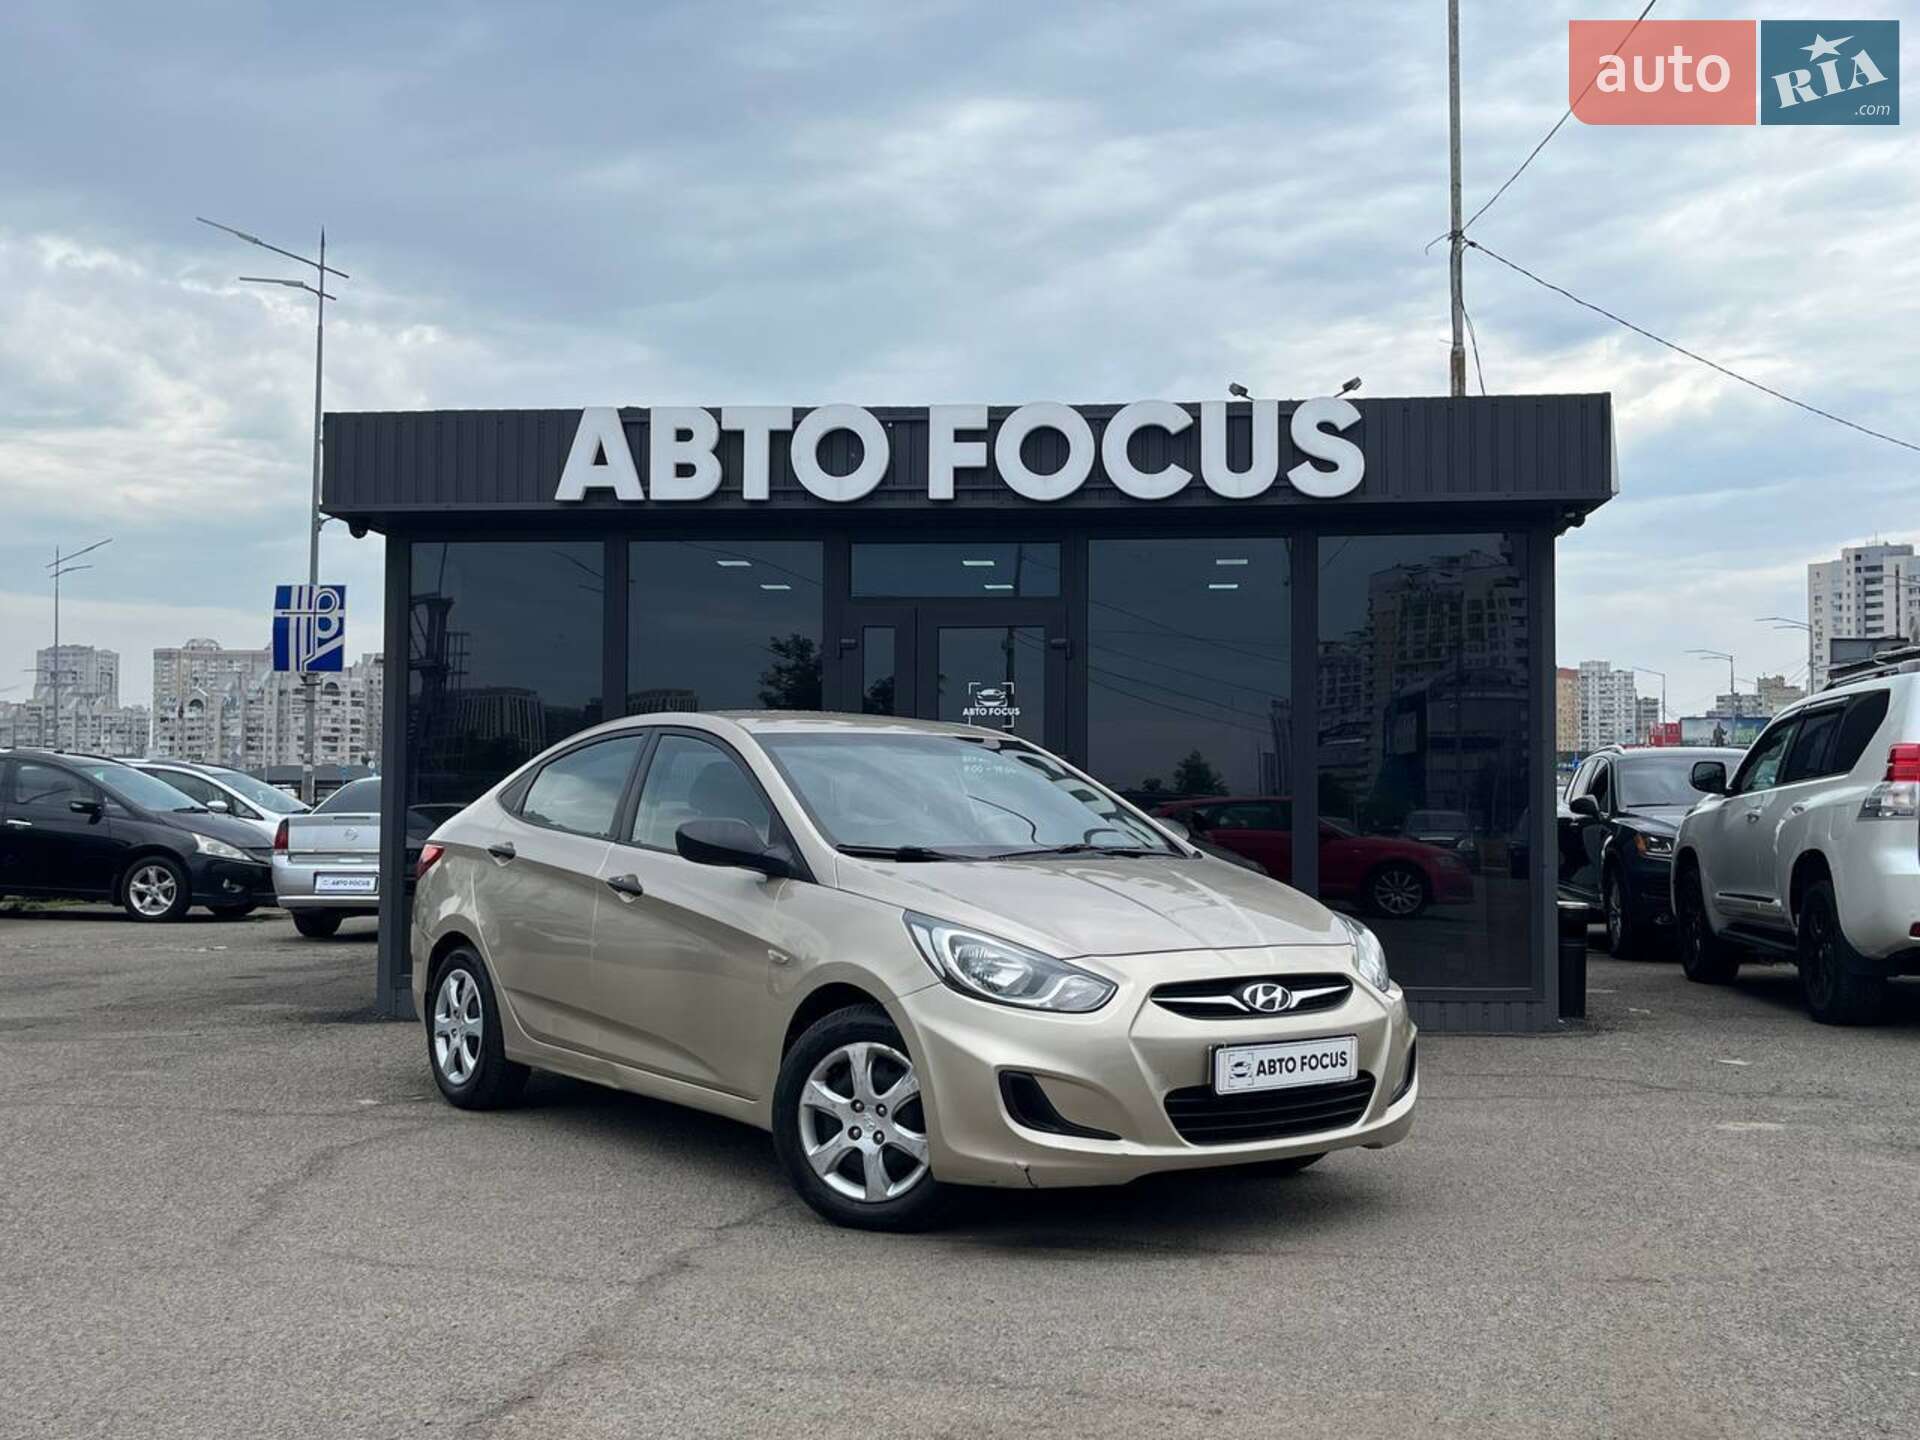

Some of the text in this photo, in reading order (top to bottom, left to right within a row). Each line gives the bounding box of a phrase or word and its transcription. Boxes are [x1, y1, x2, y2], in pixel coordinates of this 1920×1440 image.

[554, 397, 1365, 502] АВТО FOCUS
[988, 707, 1021, 716] FOCUS
[1300, 1051, 1348, 1072] FOCUS
